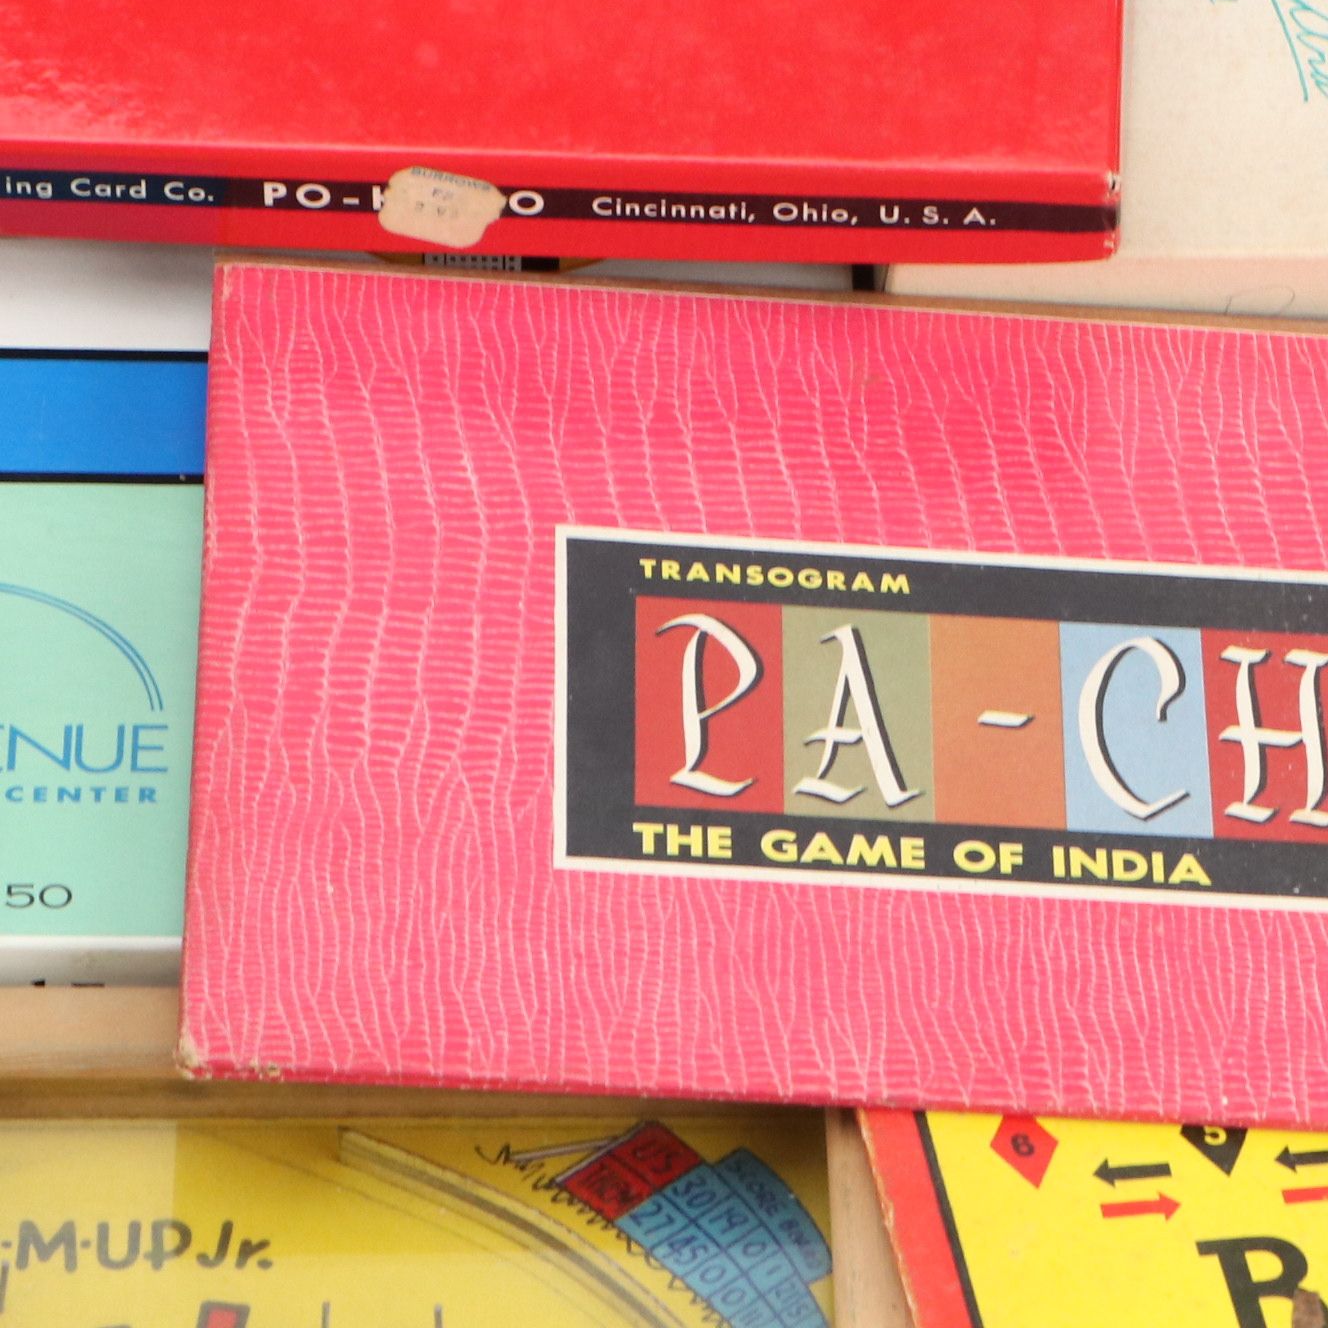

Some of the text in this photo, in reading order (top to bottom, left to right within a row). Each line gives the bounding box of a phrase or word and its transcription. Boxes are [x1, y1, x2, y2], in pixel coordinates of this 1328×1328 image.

[70, 177, 147, 201] Card
[163, 180, 215, 203] Co.
[591, 195, 757, 224] Cincinnati,
[772, 201, 859, 227] Ohio,
[639, 557, 912, 596] TRANSOGRAM
[0, 723, 169, 774] NUE
[5, 785, 157, 804] CENTER
[632, 821, 1213, 887] THE GAME OF INDIA
